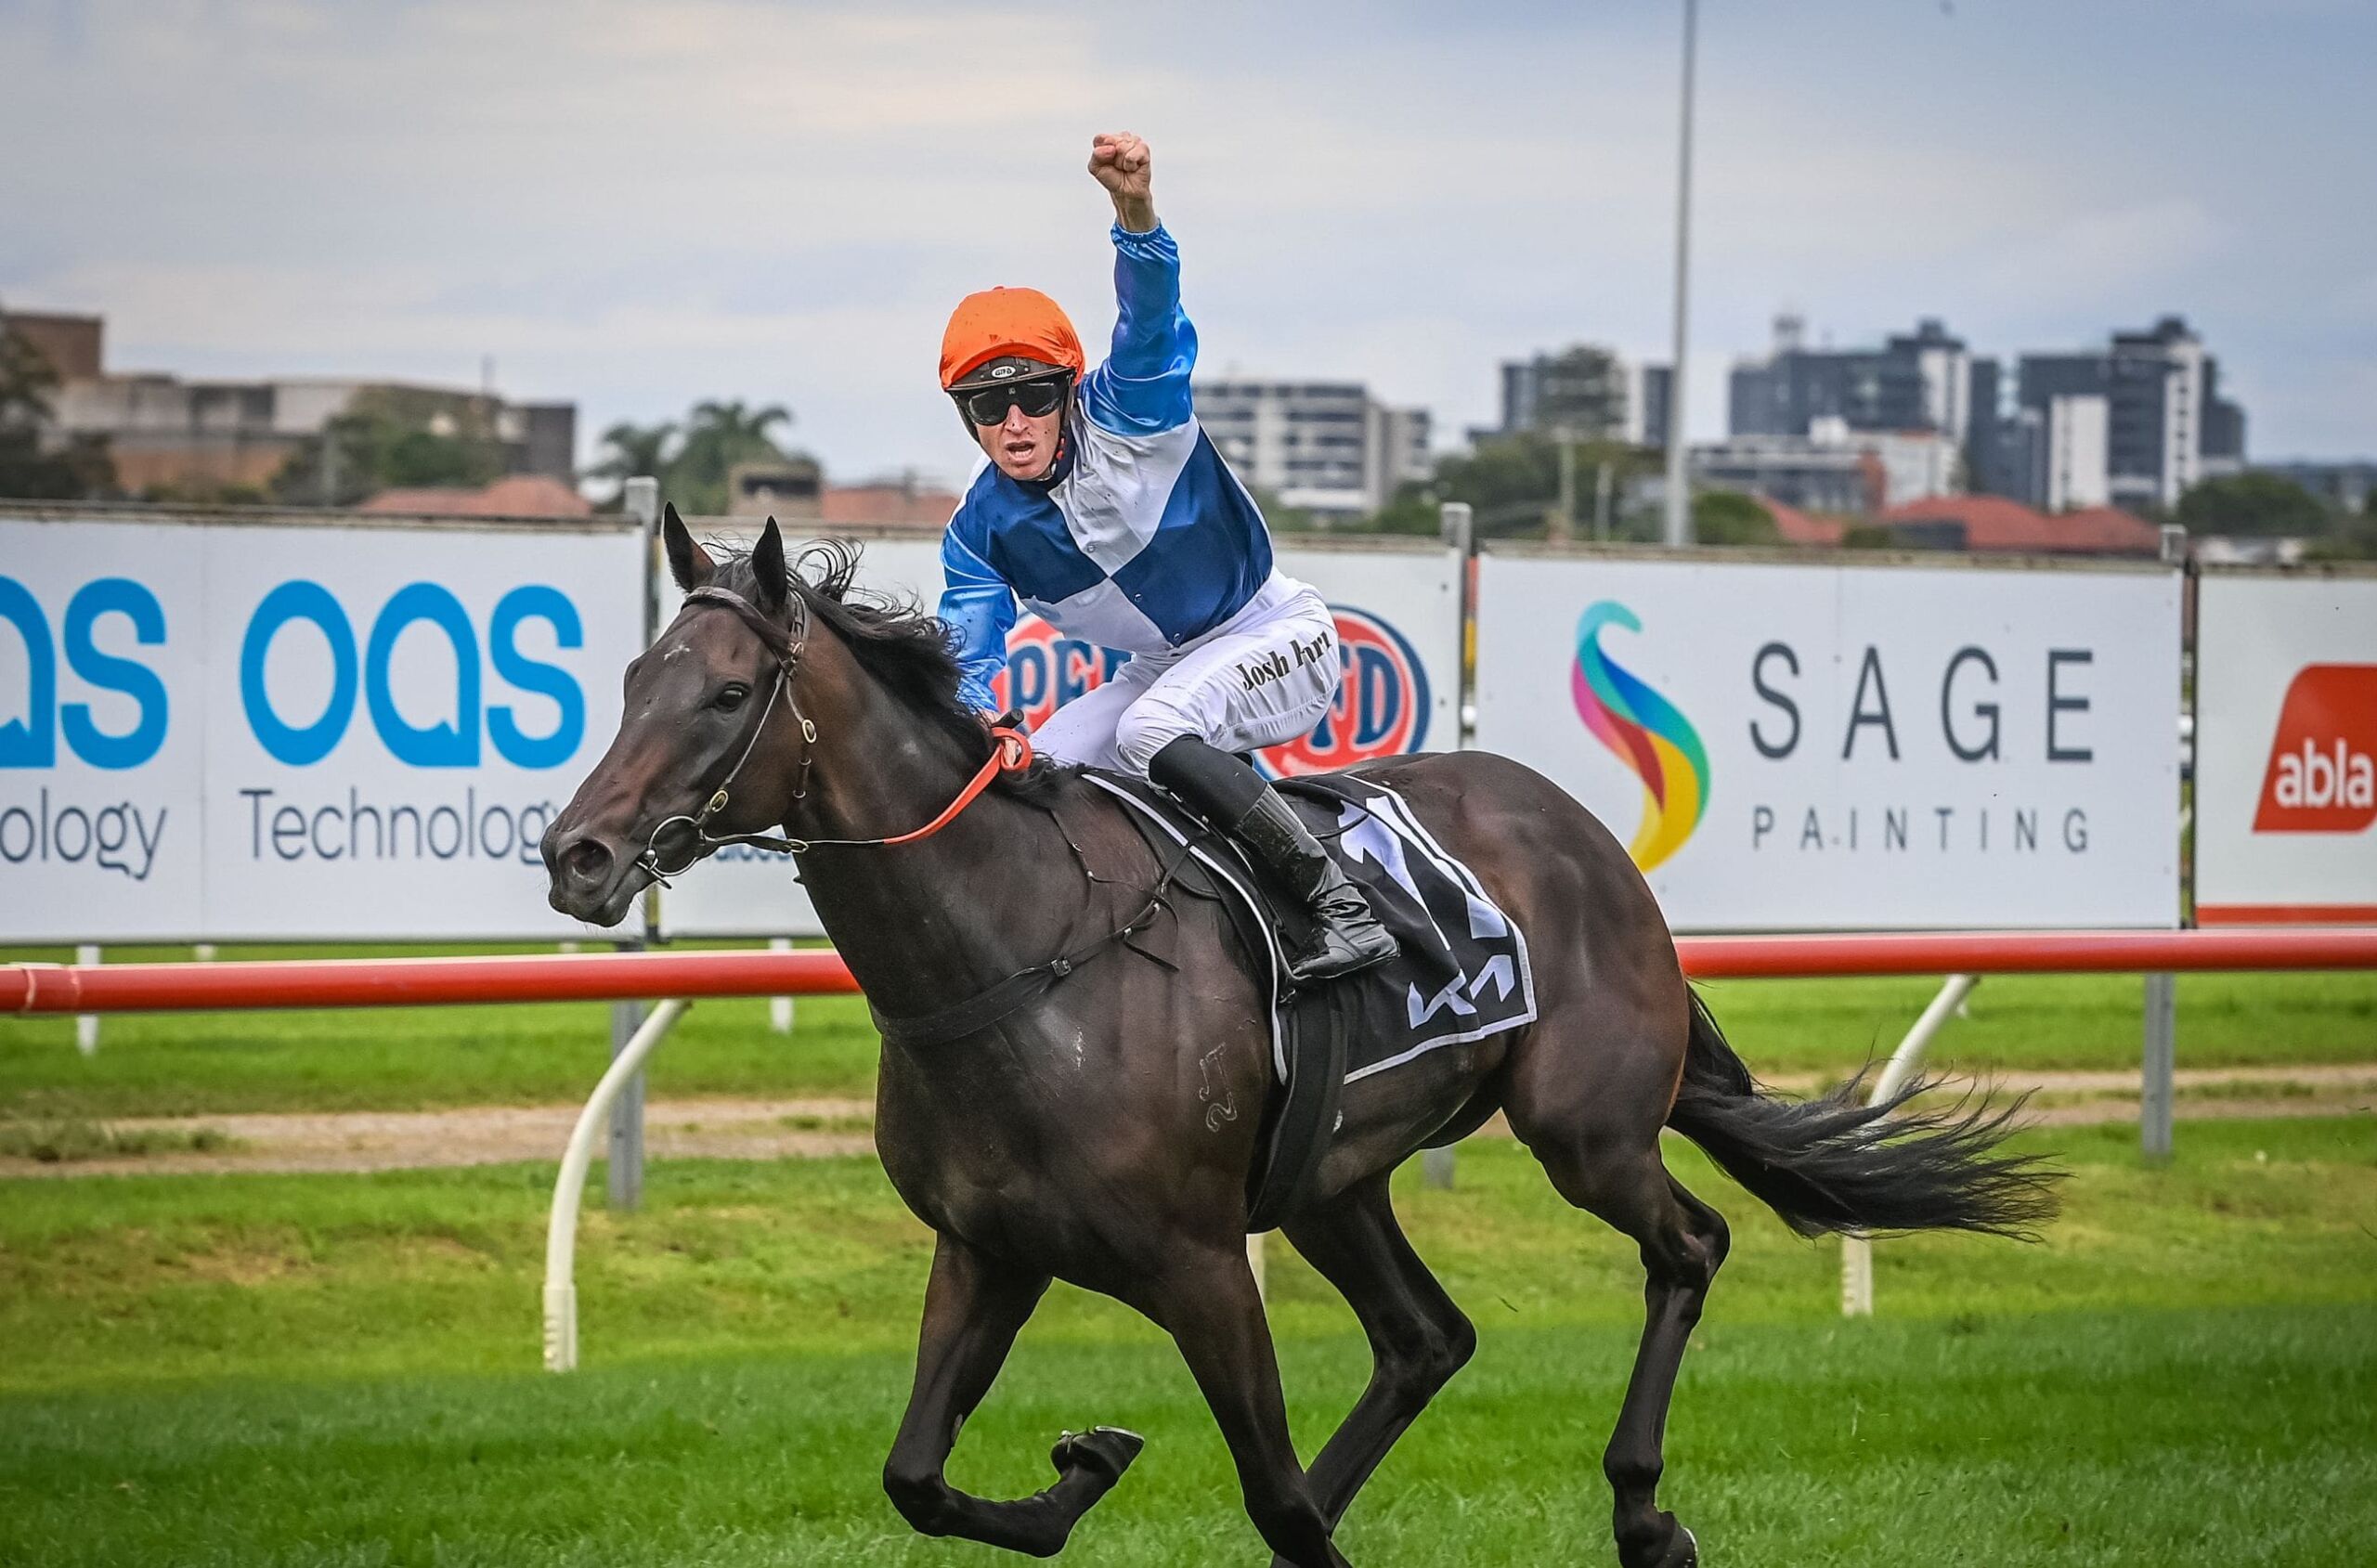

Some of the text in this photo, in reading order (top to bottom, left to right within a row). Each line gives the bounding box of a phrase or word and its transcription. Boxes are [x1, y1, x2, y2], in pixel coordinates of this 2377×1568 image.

[1236, 650, 1291, 691] Josh
[1748, 641, 2094, 764] SAGE
[2275, 736, 2375, 809] abla
[239, 787, 557, 866] Technolog
[1752, 806, 2088, 853] PAINTING
